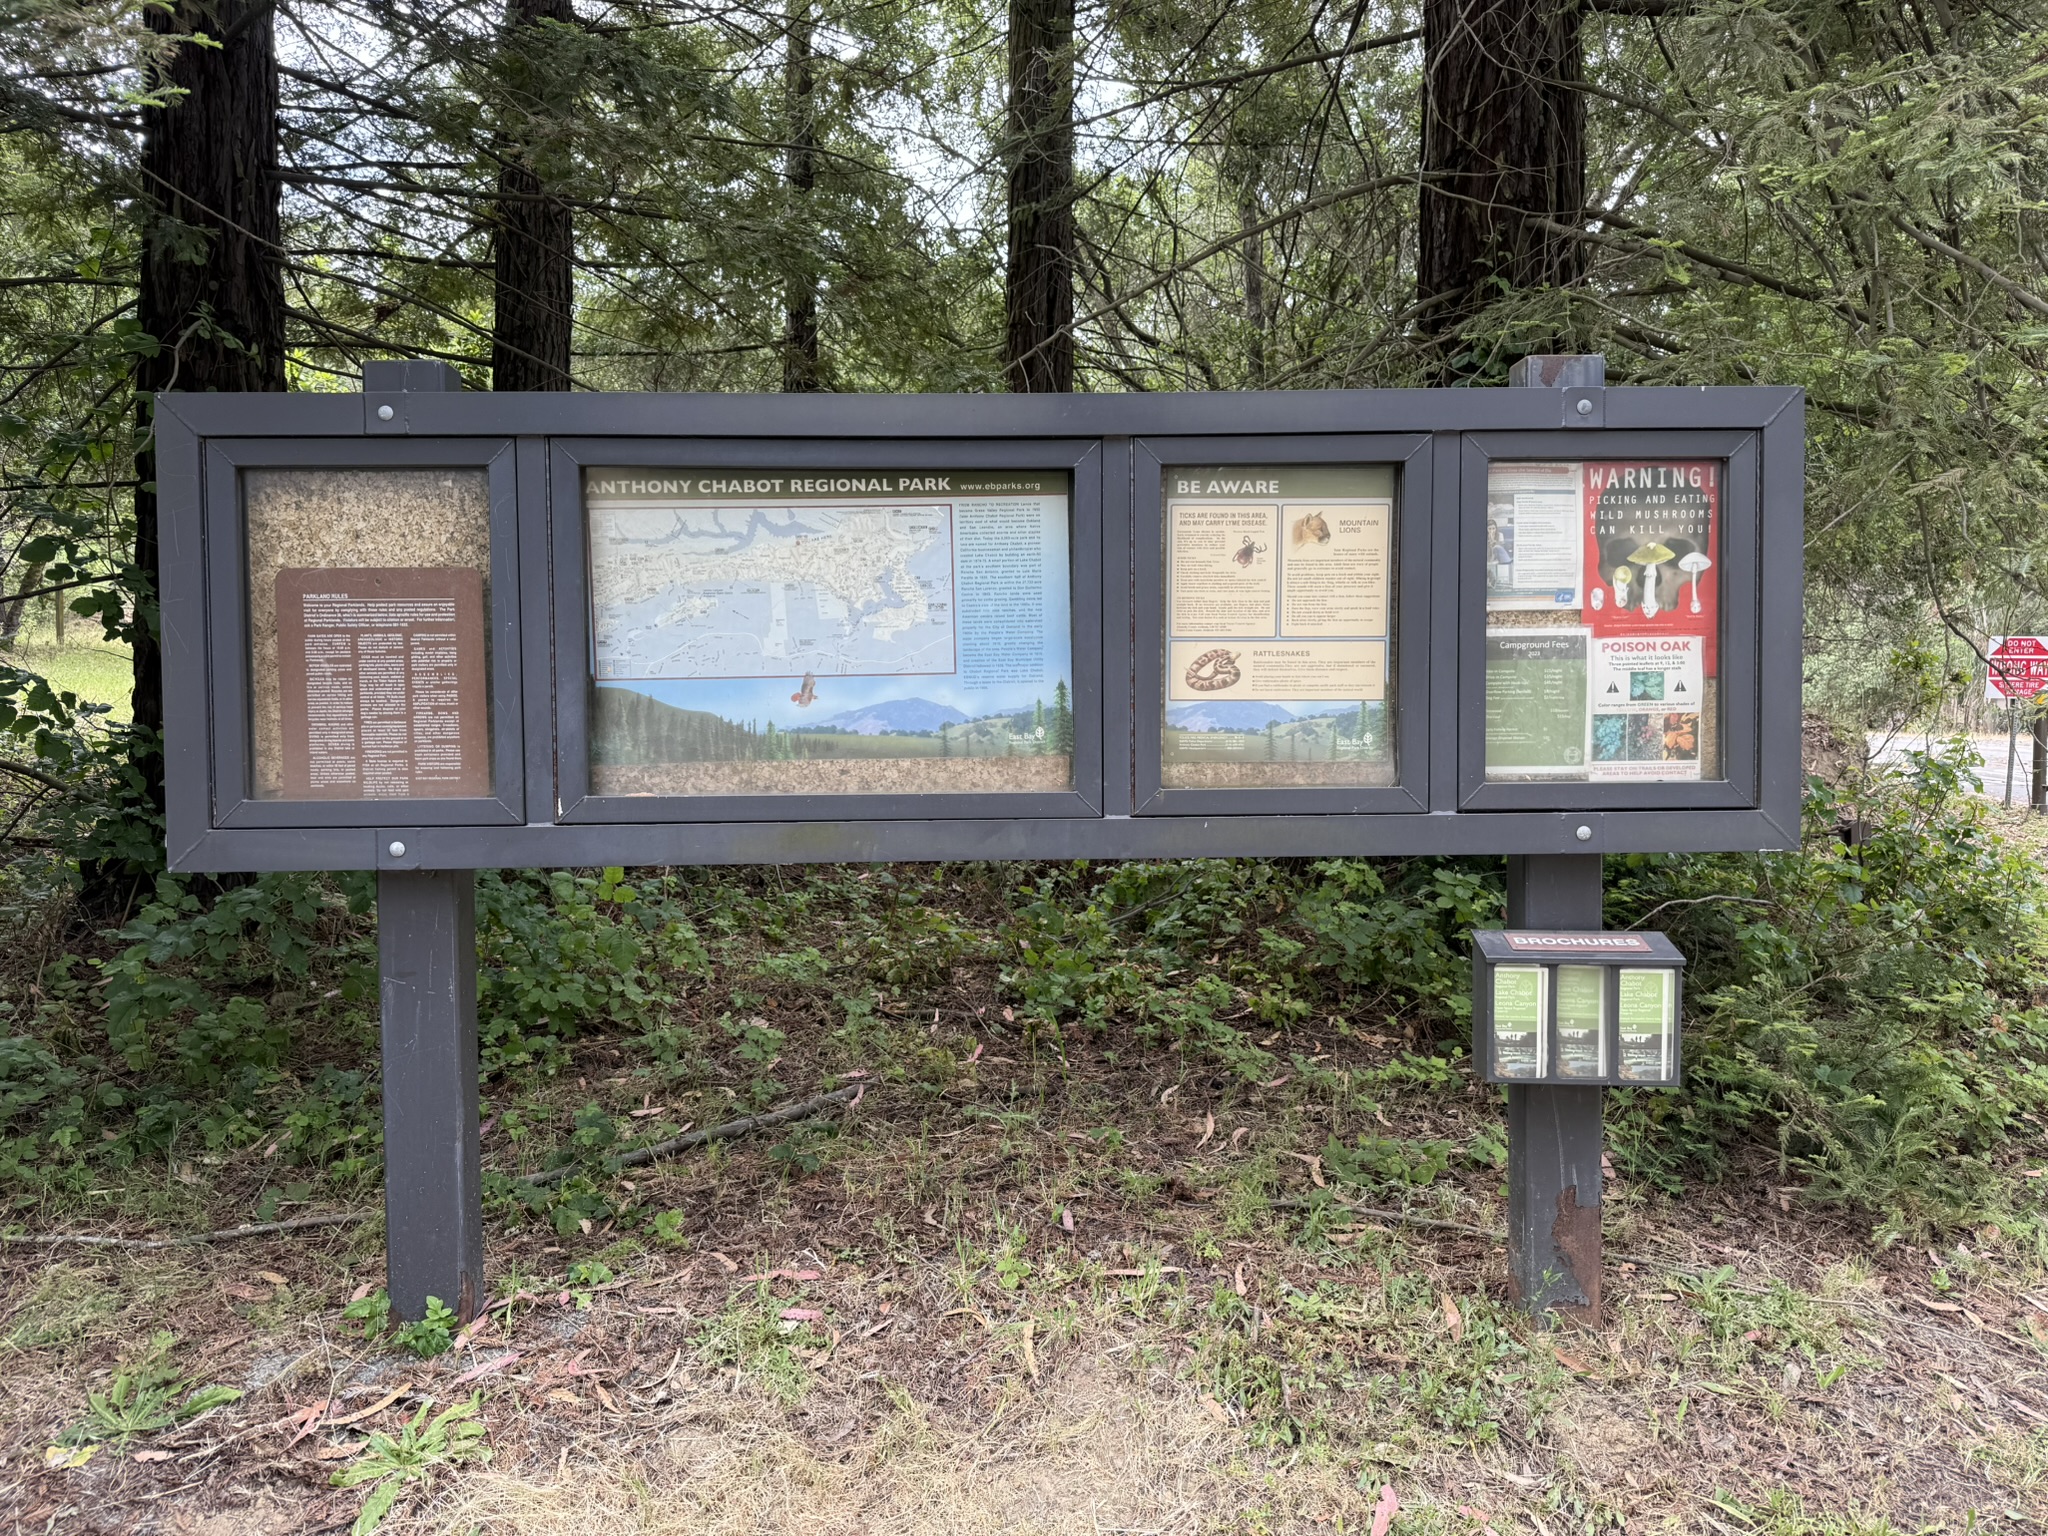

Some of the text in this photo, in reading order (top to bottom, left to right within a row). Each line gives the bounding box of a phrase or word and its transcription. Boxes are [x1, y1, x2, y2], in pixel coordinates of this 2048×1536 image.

[1589, 467, 1715, 489] WARNING!
[586, 477, 1041, 494] ANTHONY CHABOT REGIONAL PARK www.ebparks.org
[1177, 480, 1280, 494] BE AWARE
[1589, 494, 1715, 505] PICKING AND EATING
[1590, 510, 1713, 519] WILD MUSHROOMS
[1590, 524, 1711, 534] CAN KILL YOU!
[1500, 640, 1570, 650] Campground Fees
[1602, 641, 1691, 653] POISON OAK
[1352, 738, 1363, 746] Bay
[1513, 937, 1640, 946] BROCHURES
